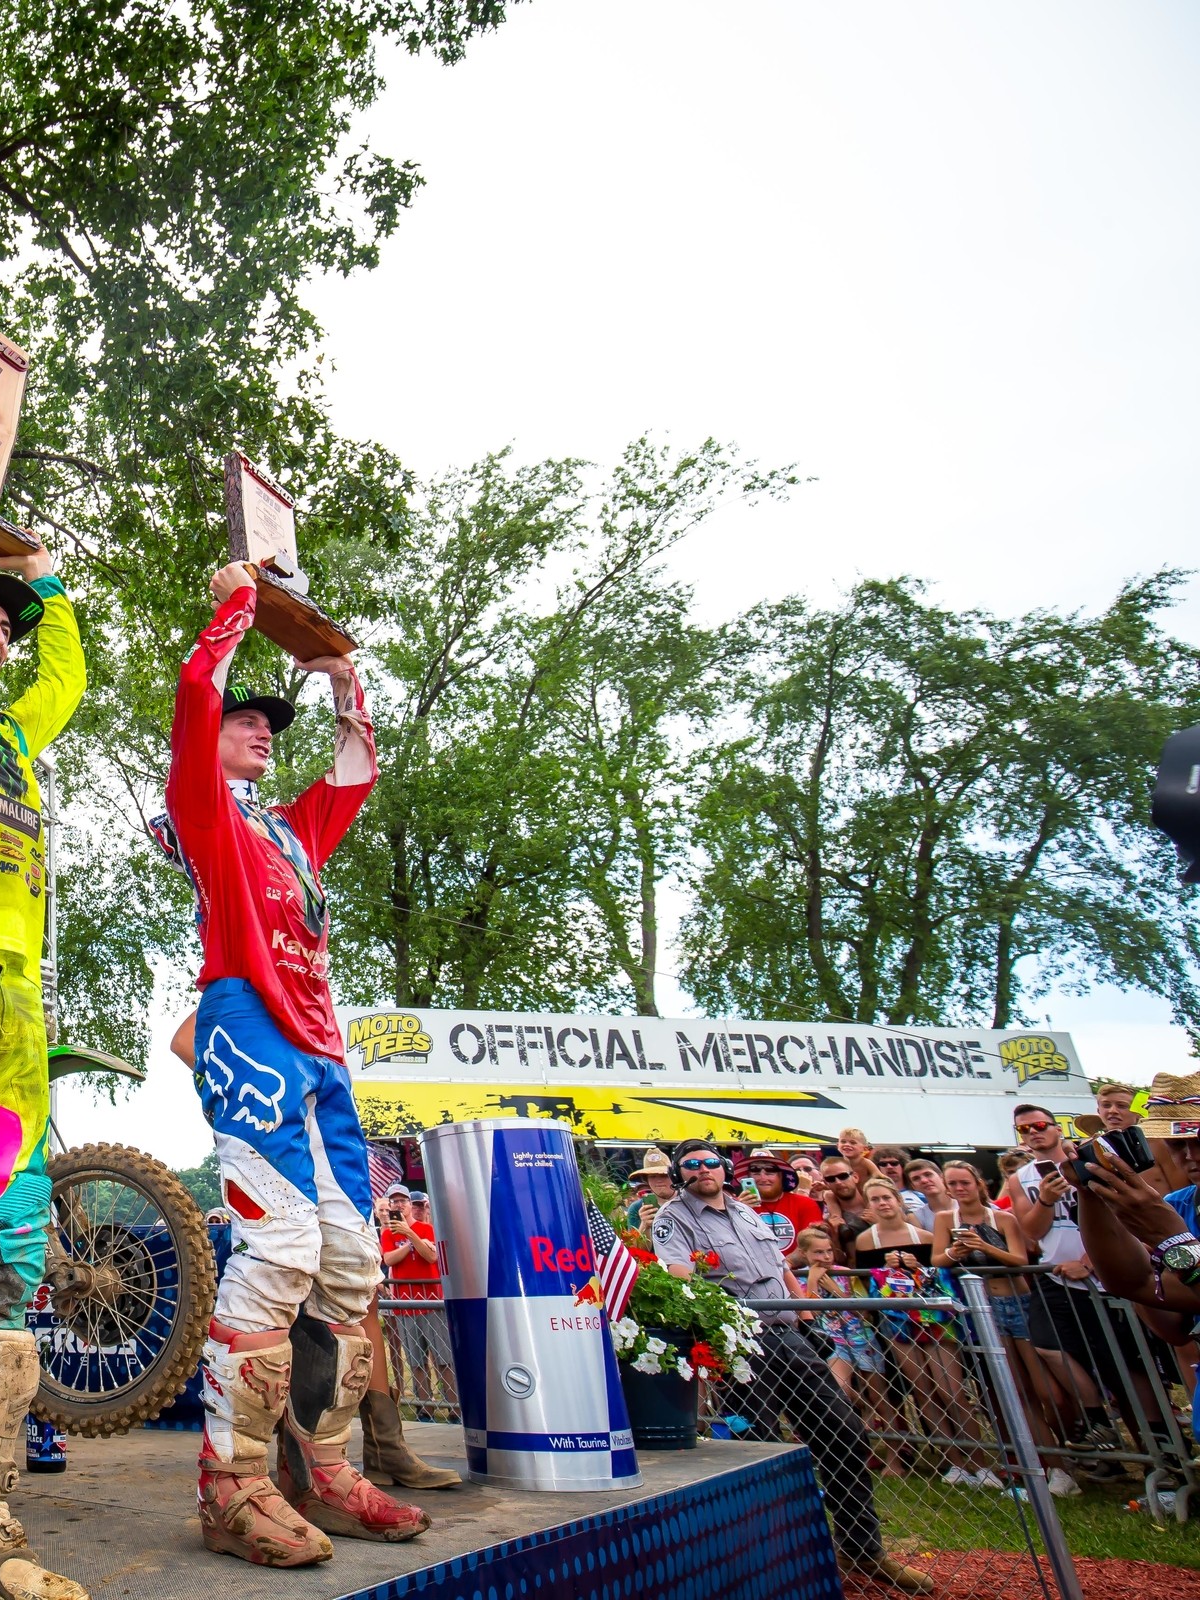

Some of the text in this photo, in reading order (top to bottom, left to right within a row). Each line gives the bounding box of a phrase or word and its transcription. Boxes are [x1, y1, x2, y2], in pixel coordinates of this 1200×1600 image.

[349, 1014, 422, 1044] MOTO
[362, 1033, 432, 1067] TEES
[449, 1023, 992, 1080] OFFICIAL MERCHANDISE
[1000, 1036, 1055, 1065] MOTO
[1013, 1051, 1070, 1086] TEES
[512, 1151, 534, 1161] Lightly
[514, 1160, 533, 1168] Serve
[529, 1235, 592, 1272] Red
[1157, 1231, 1196, 1252] REDBUD
[549, 1436, 575, 1449] With
[576, 1436, 610, 1449] Taurine.
